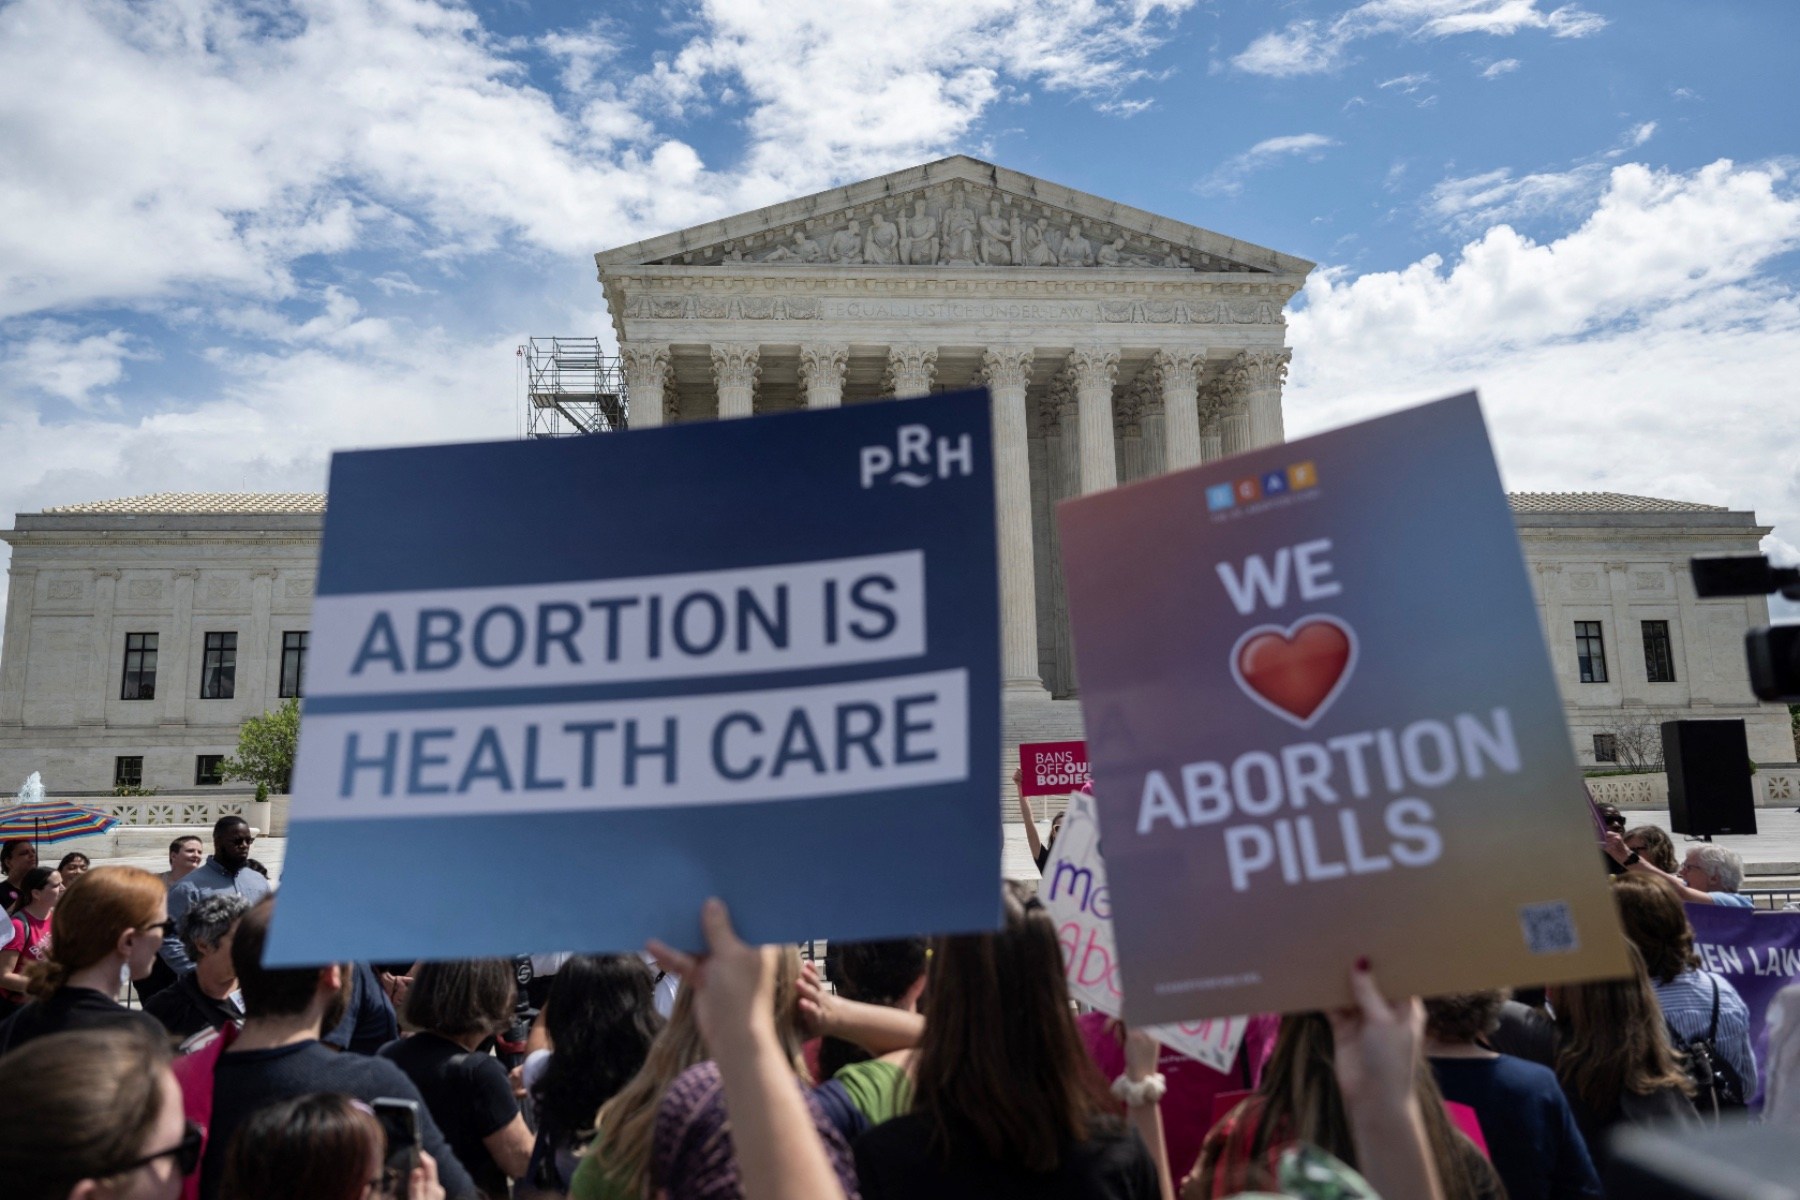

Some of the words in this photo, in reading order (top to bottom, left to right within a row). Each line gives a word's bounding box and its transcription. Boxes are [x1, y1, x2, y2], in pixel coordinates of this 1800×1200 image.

[836, 303, 896, 317] EQUAL
[902, 304, 976, 317] JUSTICE
[982, 304, 1041, 318] UNDER
[1049, 305, 1084, 318] LAW
[860, 424, 973, 488] PRH
[1215, 538, 1343, 616] WE
[349, 583, 789, 676] ABORTION
[824, 573, 898, 645] IS
[338, 716, 679, 798] HEALTH
[711, 692, 938, 780] CARE
[1035, 751, 1073, 763] BANS
[1035, 763, 1062, 774] OFF
[1136, 707, 1522, 836] ABORTION
[1227, 800, 1442, 892] PILLS
